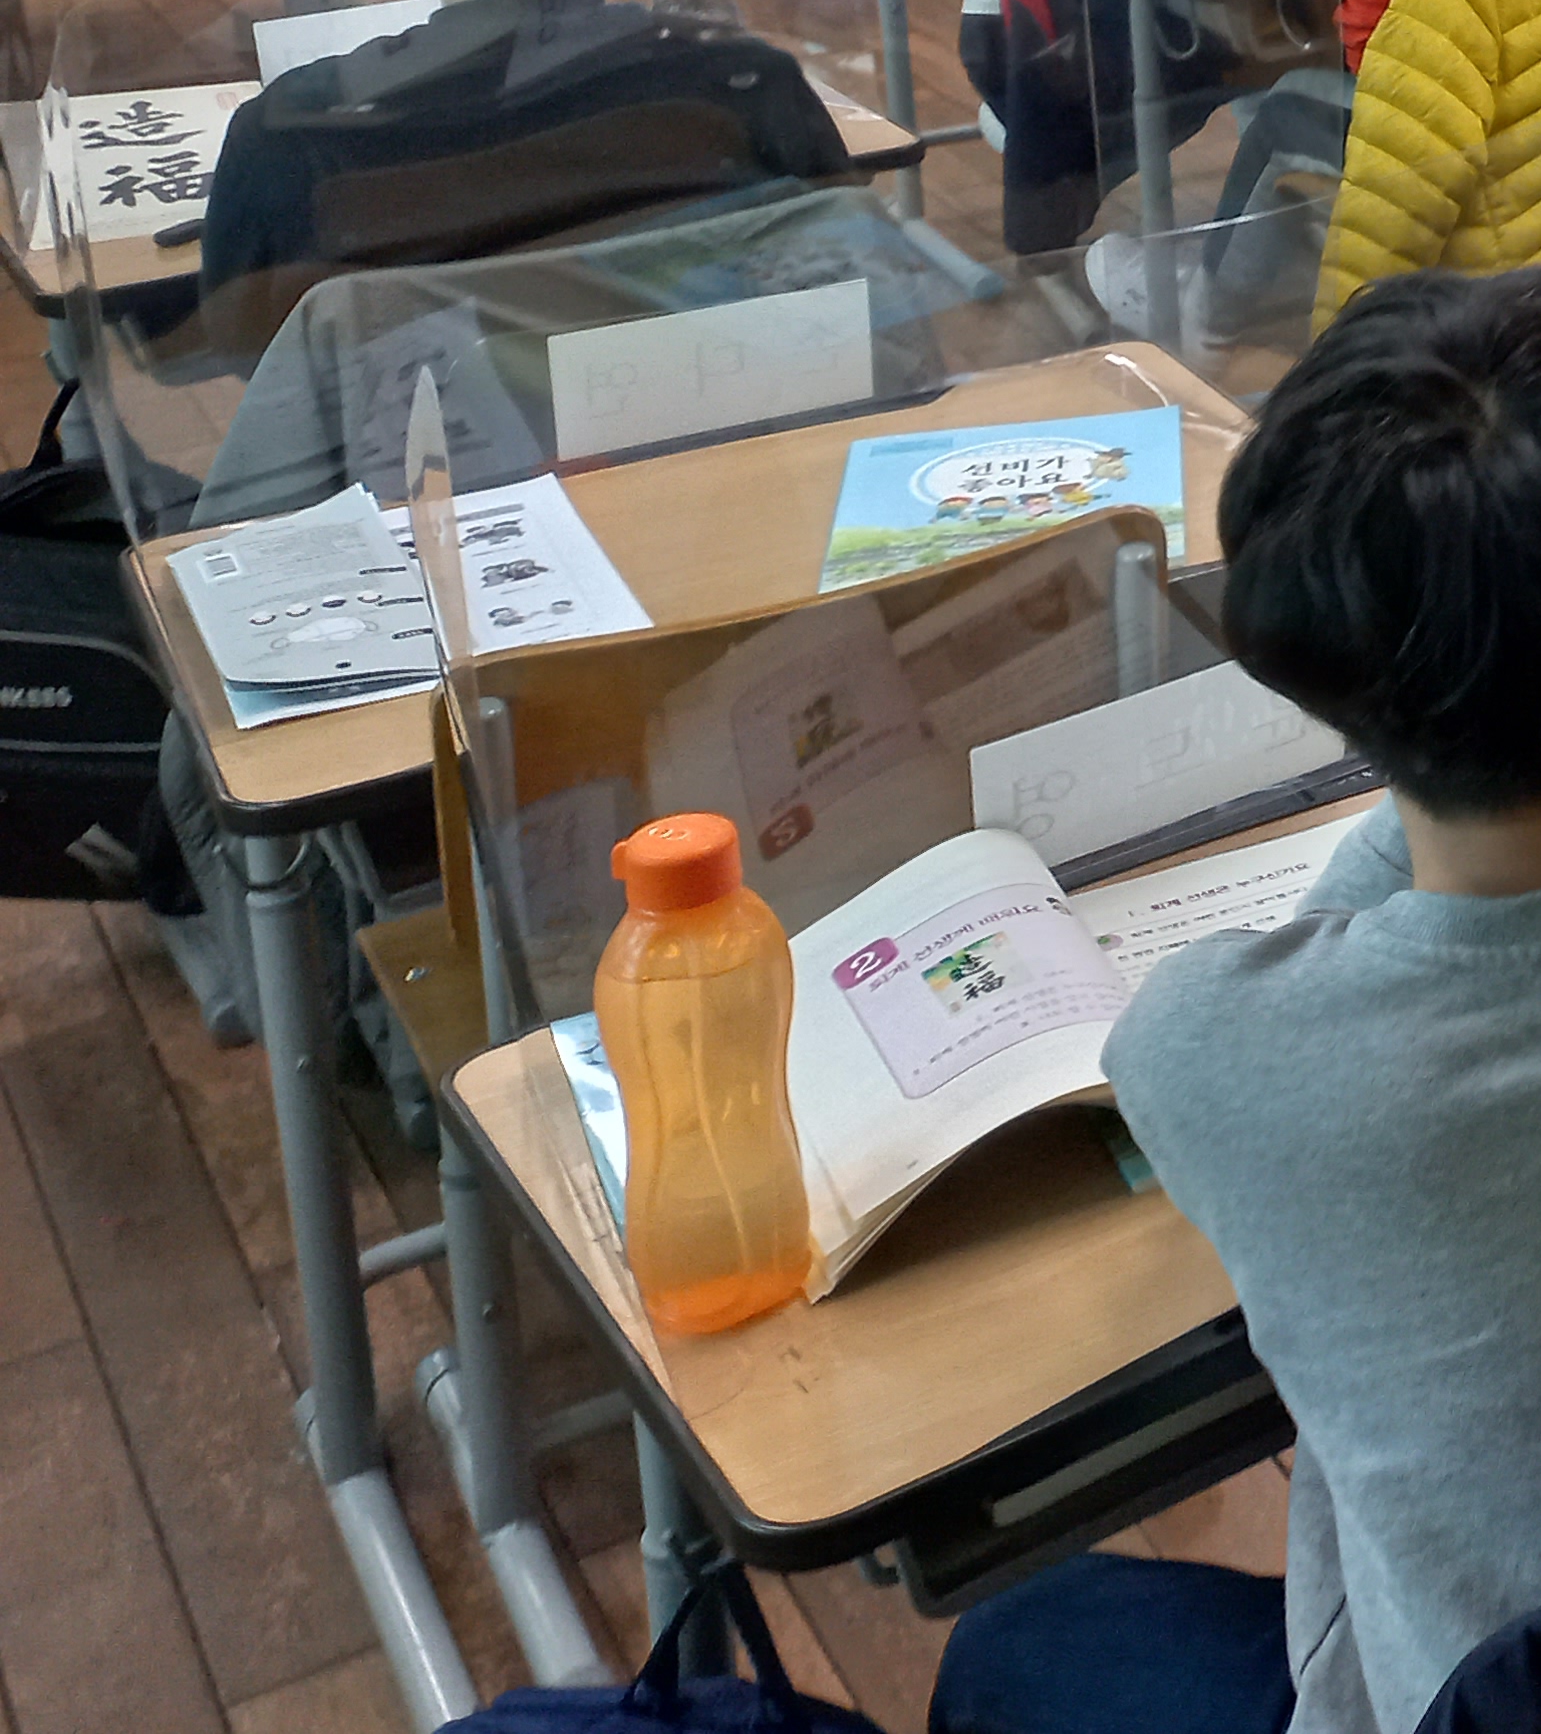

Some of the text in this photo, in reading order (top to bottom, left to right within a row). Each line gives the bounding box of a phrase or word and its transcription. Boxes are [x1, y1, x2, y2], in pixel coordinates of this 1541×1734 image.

[962, 455, 1070, 477] 선비가
[958, 472, 1070, 493] 좋아요
[849, 950, 882, 980] 2
